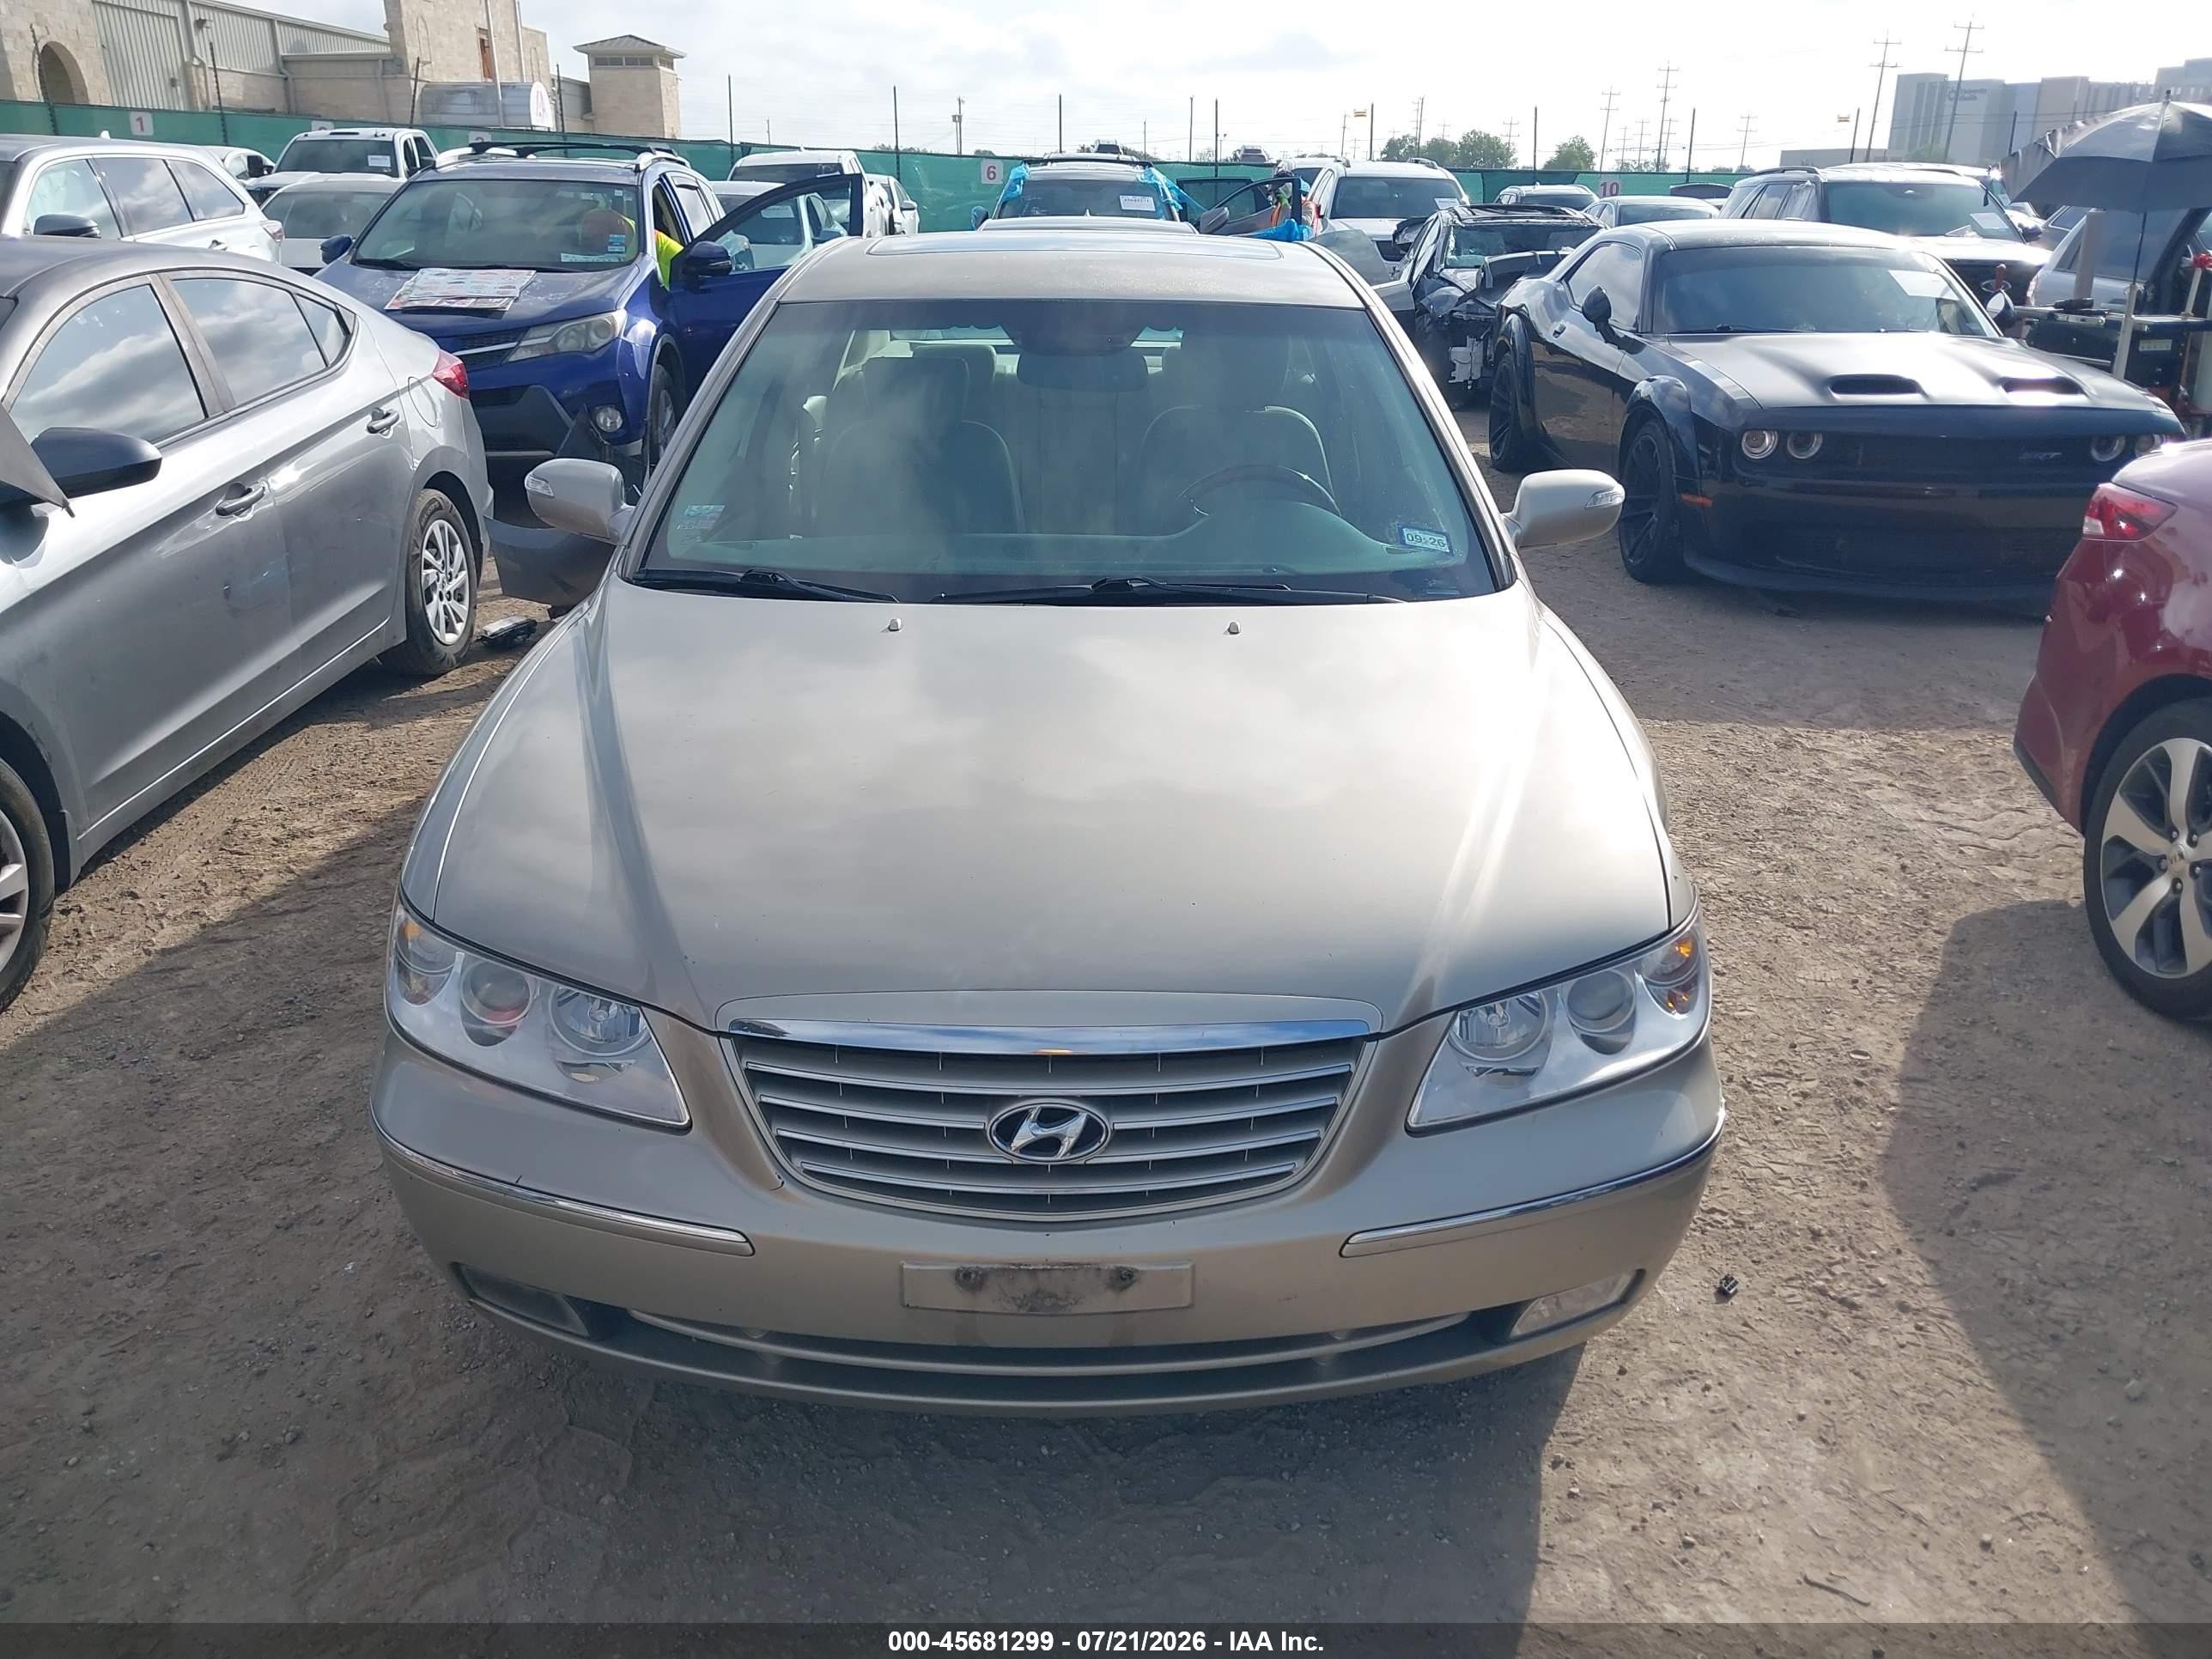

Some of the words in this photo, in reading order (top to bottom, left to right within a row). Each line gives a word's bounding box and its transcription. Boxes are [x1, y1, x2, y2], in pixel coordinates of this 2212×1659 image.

[136, 116, 144, 131] 1
[987, 165, 996, 180] 6
[1600, 181, 1620, 197] 10
